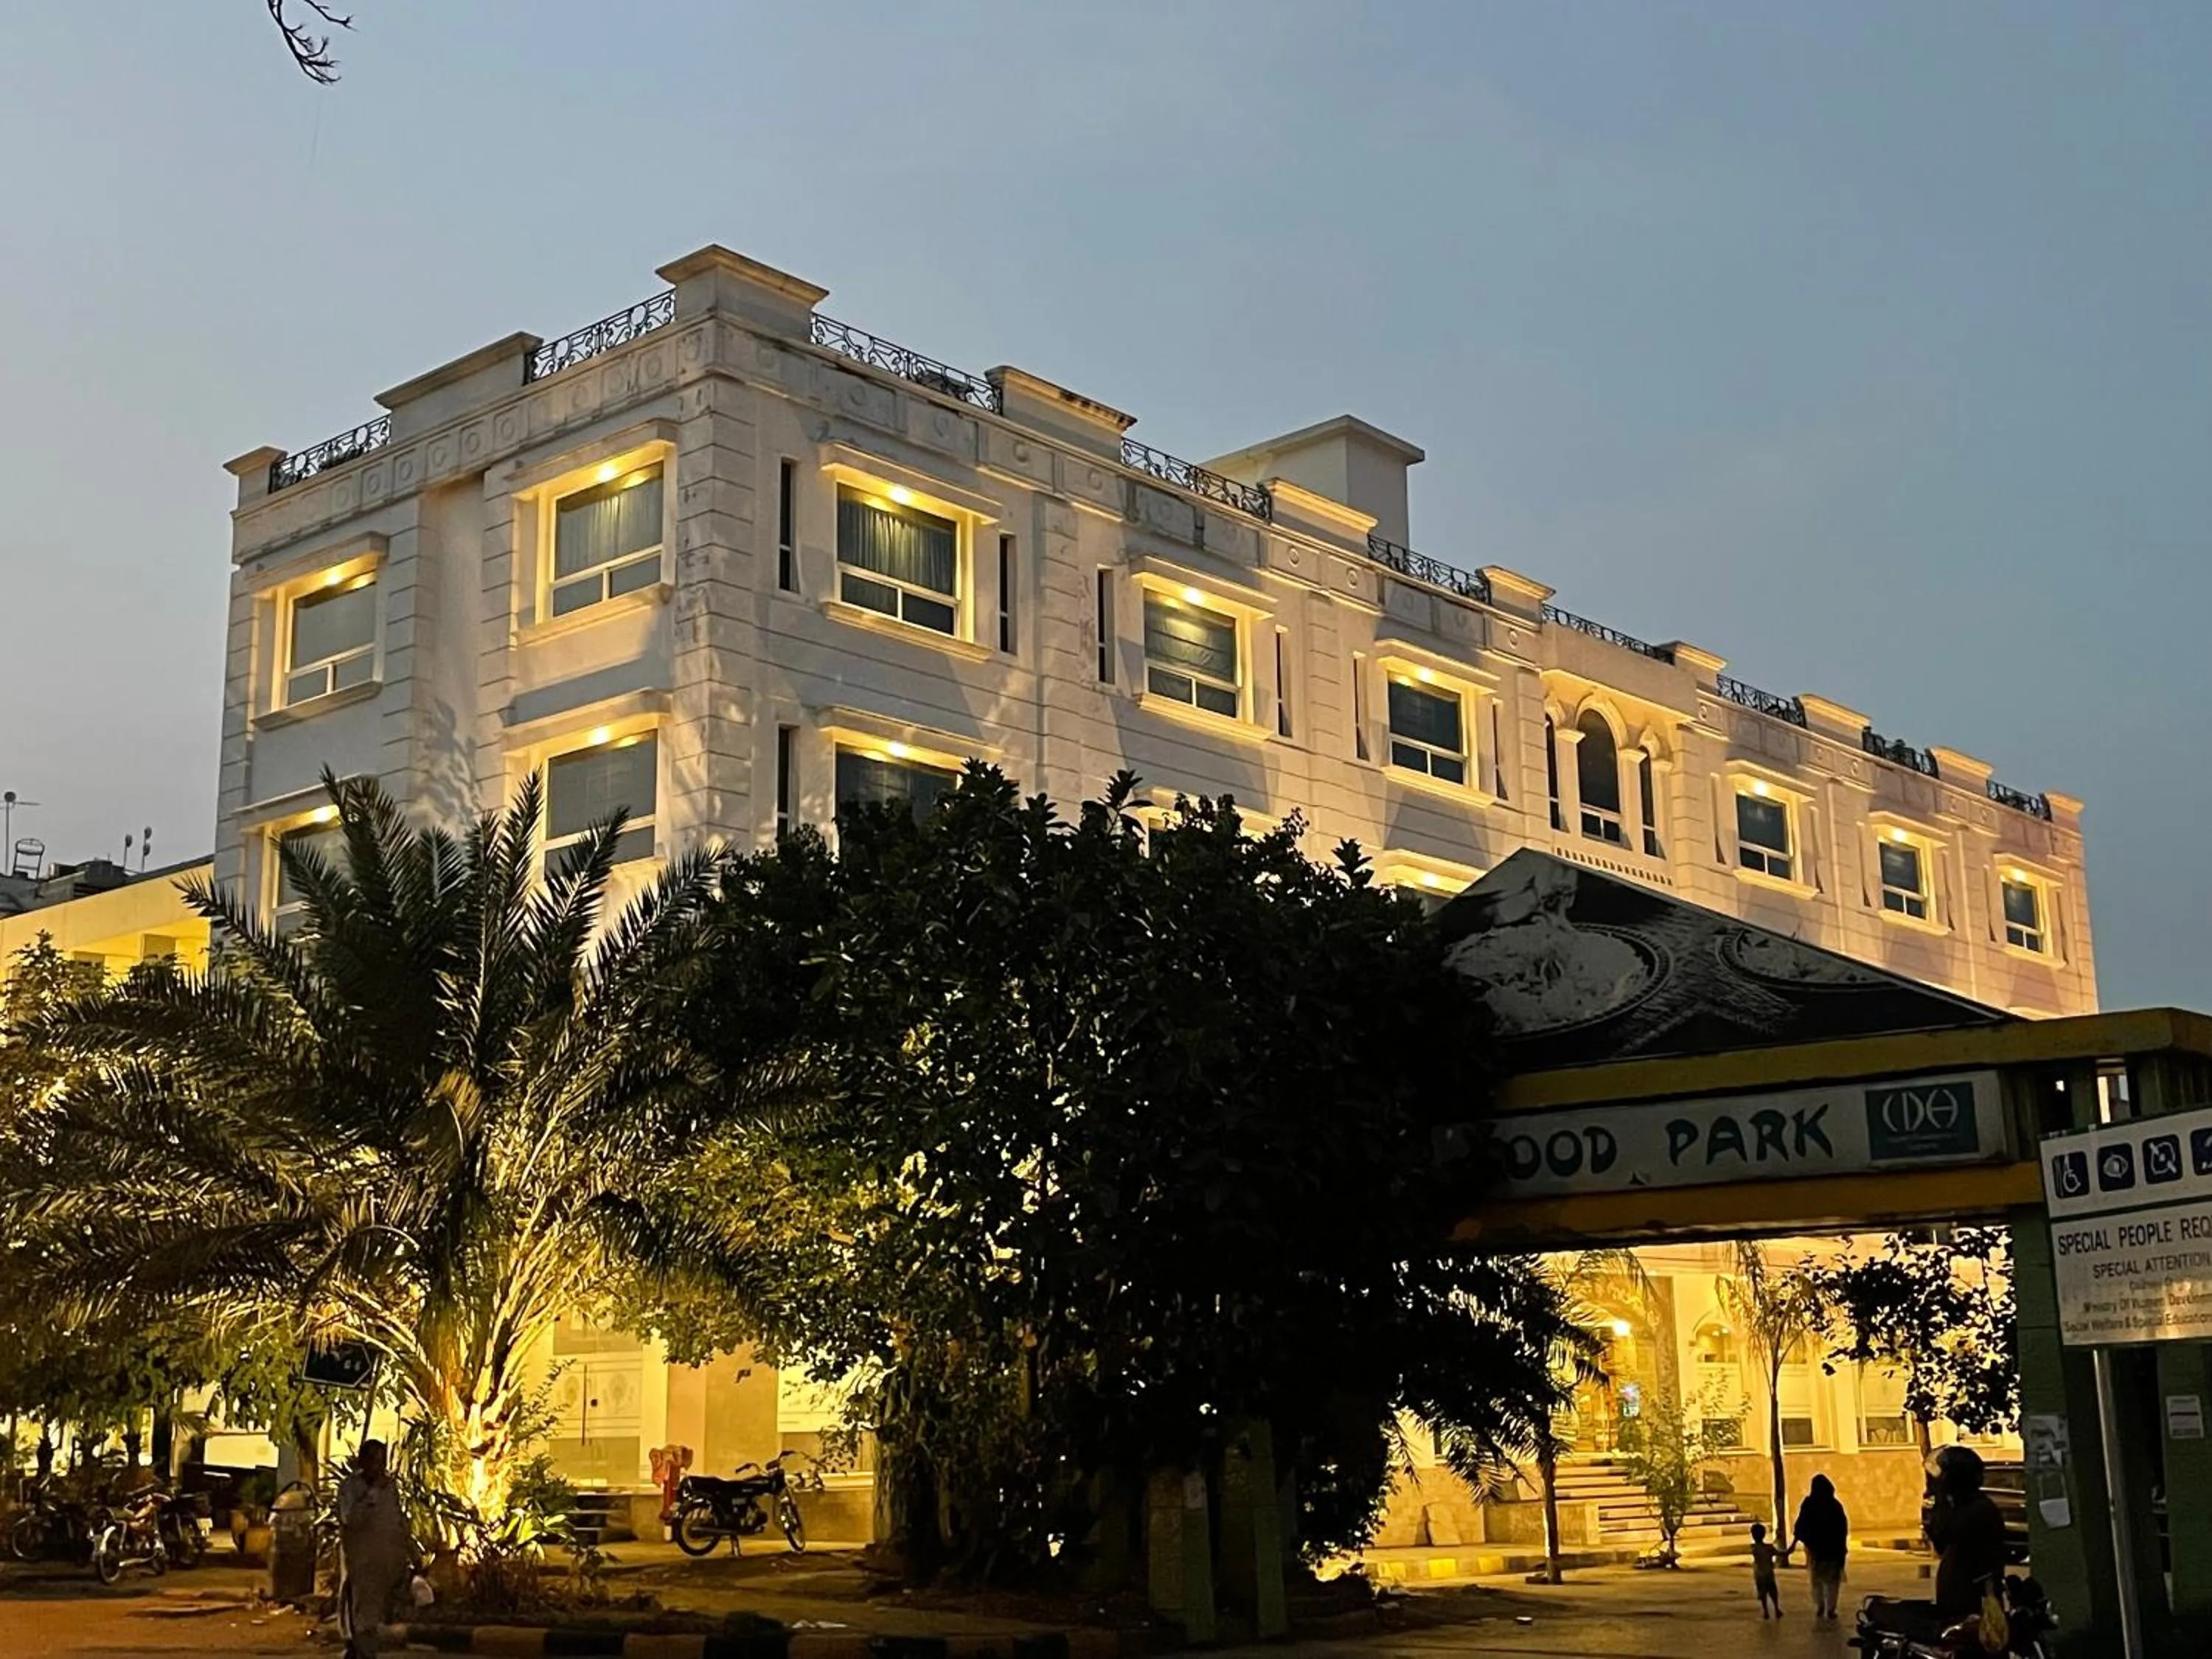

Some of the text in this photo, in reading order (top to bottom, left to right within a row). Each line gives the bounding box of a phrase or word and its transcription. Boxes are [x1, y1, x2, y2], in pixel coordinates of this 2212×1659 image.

[1503, 1104, 1835, 1180] OOD PARK
[2058, 1214, 2212, 1256] SPECIAL PEOPLE REQ
[2093, 1251, 2211, 1279] SPECIAL ATTENTION
